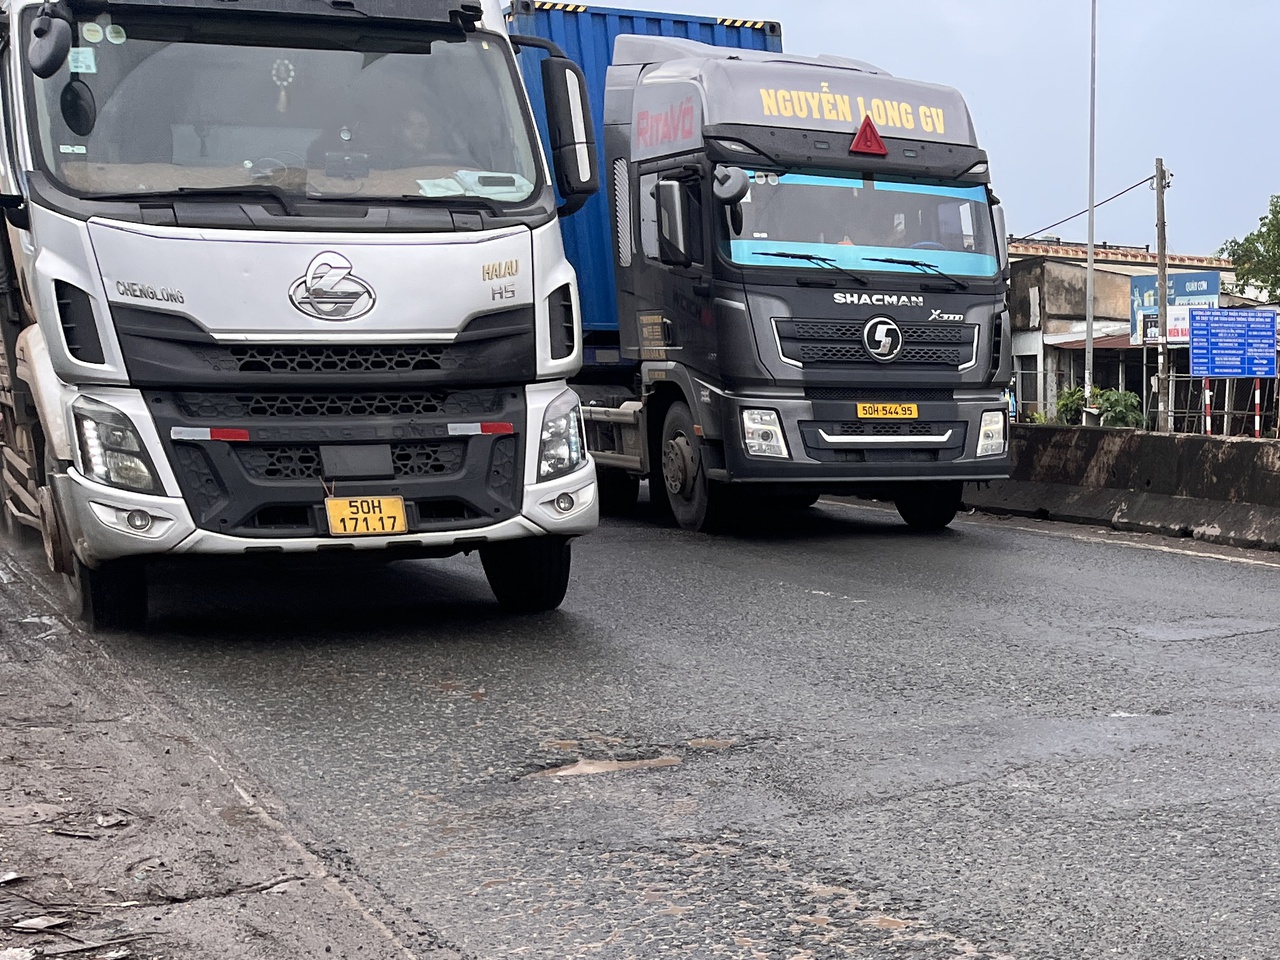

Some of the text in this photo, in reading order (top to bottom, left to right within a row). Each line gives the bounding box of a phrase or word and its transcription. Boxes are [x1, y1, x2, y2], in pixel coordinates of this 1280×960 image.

[759, 82, 945, 134] NGUYỄN LONG GV
[482, 259, 519, 281] HALAU
[116, 280, 185, 304] CHENGLONG
[833, 293, 924, 306] SHACMAN
[349, 500, 383, 516] 50H
[340, 516, 397, 533] 171.17
